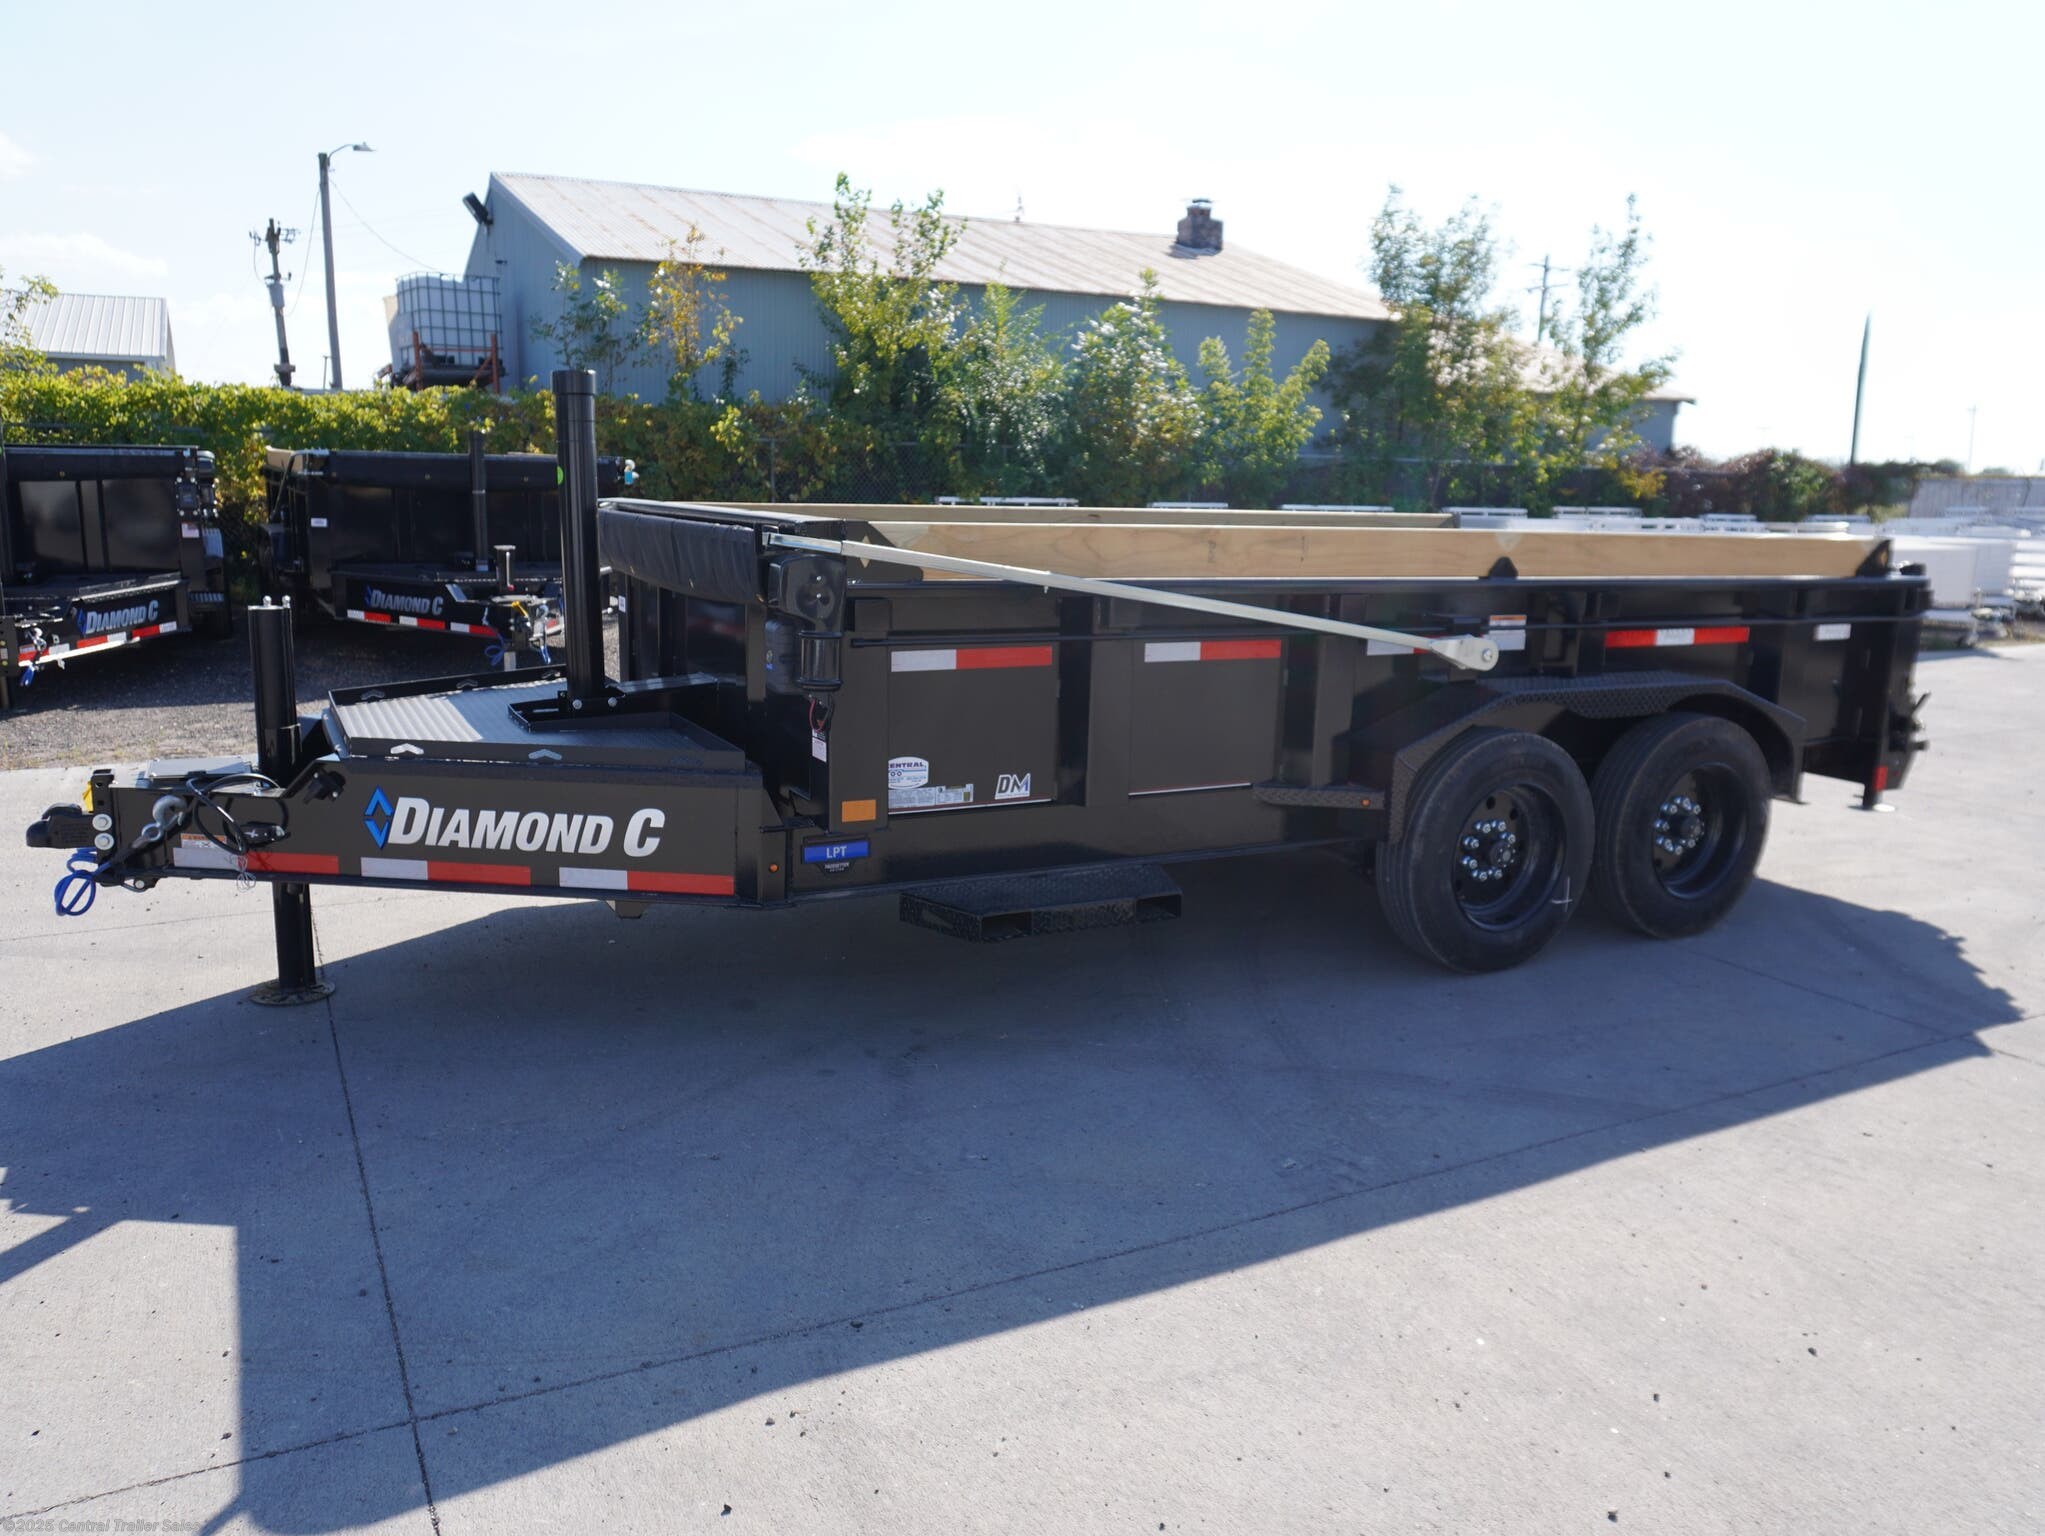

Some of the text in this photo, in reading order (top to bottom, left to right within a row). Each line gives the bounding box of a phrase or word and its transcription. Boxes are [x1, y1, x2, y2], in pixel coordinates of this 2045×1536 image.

[85, 600, 159, 634] DIAMOND C
[371, 589, 444, 615] DIAMOND C
[388, 796, 666, 858] DIAMOND C
[826, 844, 847, 859] LPT
